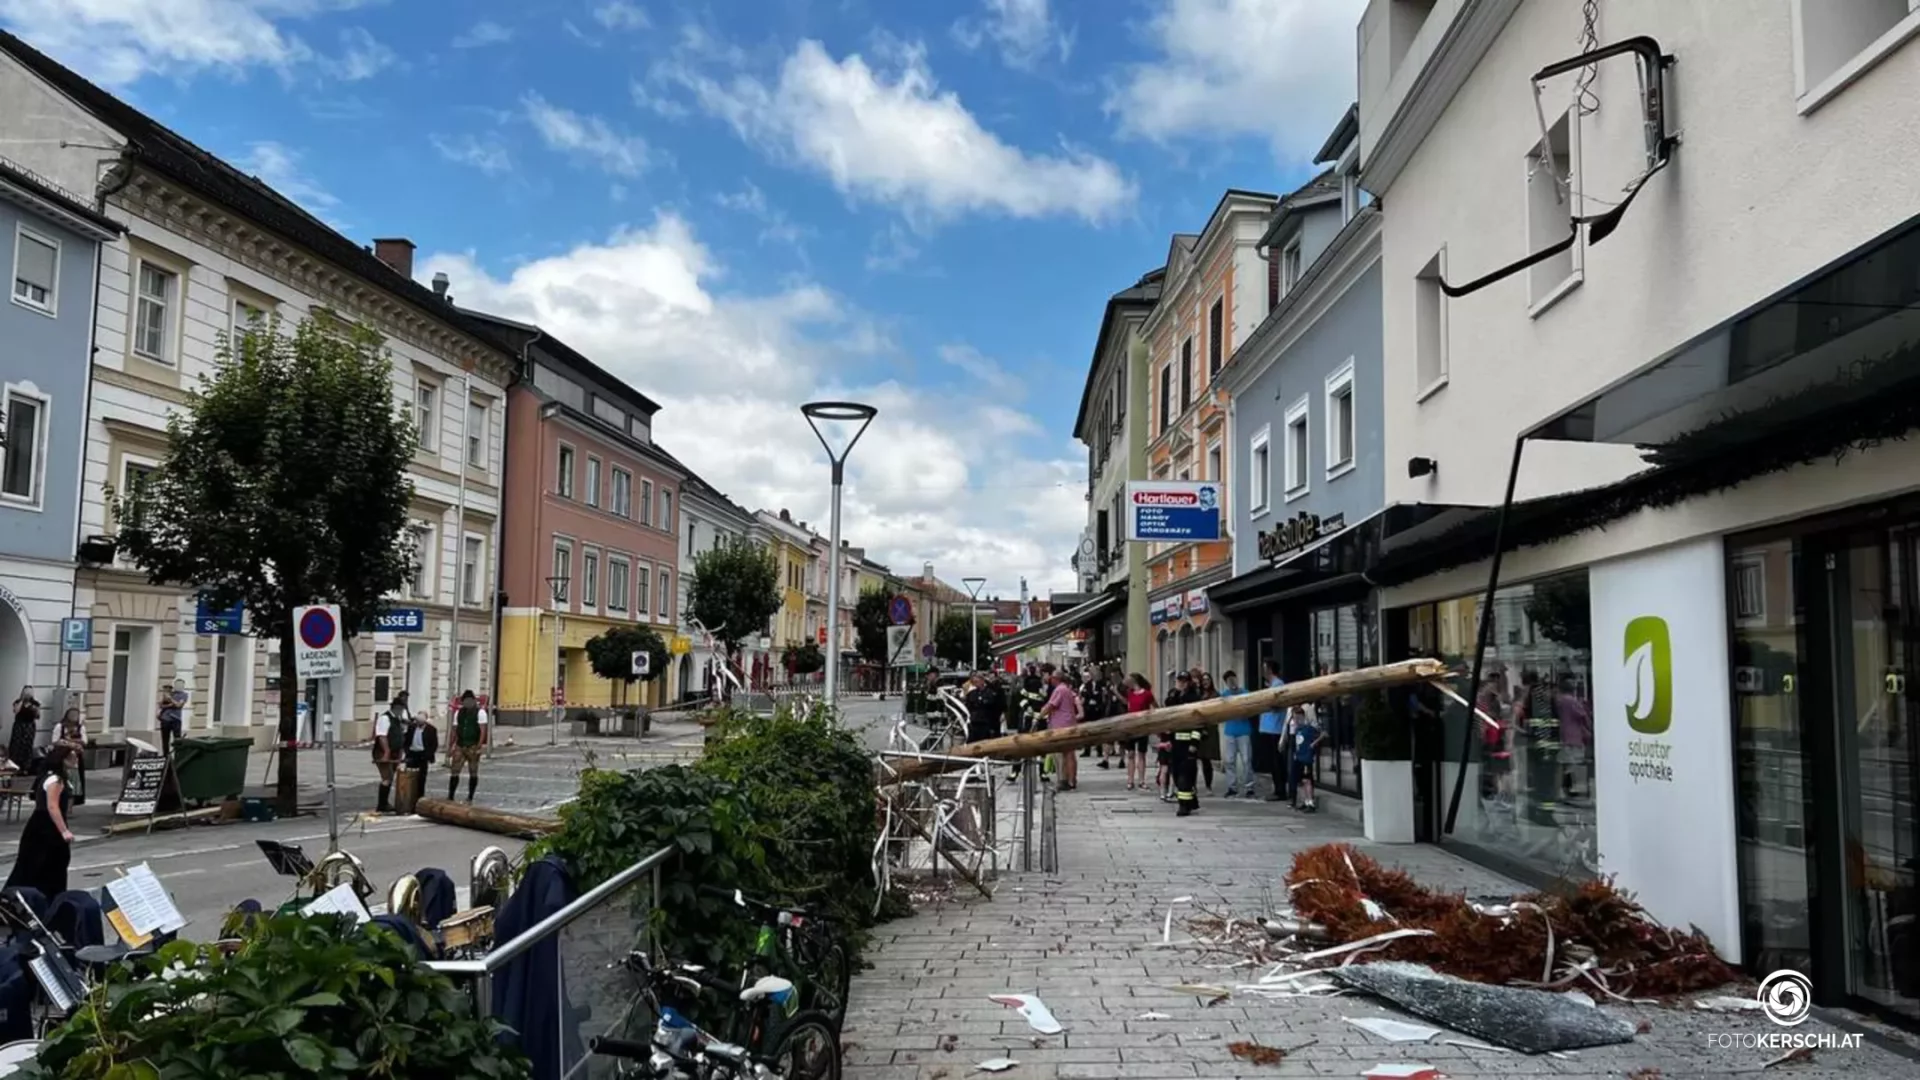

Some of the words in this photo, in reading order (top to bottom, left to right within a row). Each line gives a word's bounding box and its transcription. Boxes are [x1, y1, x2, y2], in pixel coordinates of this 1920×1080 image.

[1138, 493, 1194, 504] Hartlauer
[301, 650, 338, 660] LADEZONE
[1628, 738, 1672, 760] salvator
[132, 761, 166, 770] KONZERT
[1629, 760, 1673, 785] apotheke
